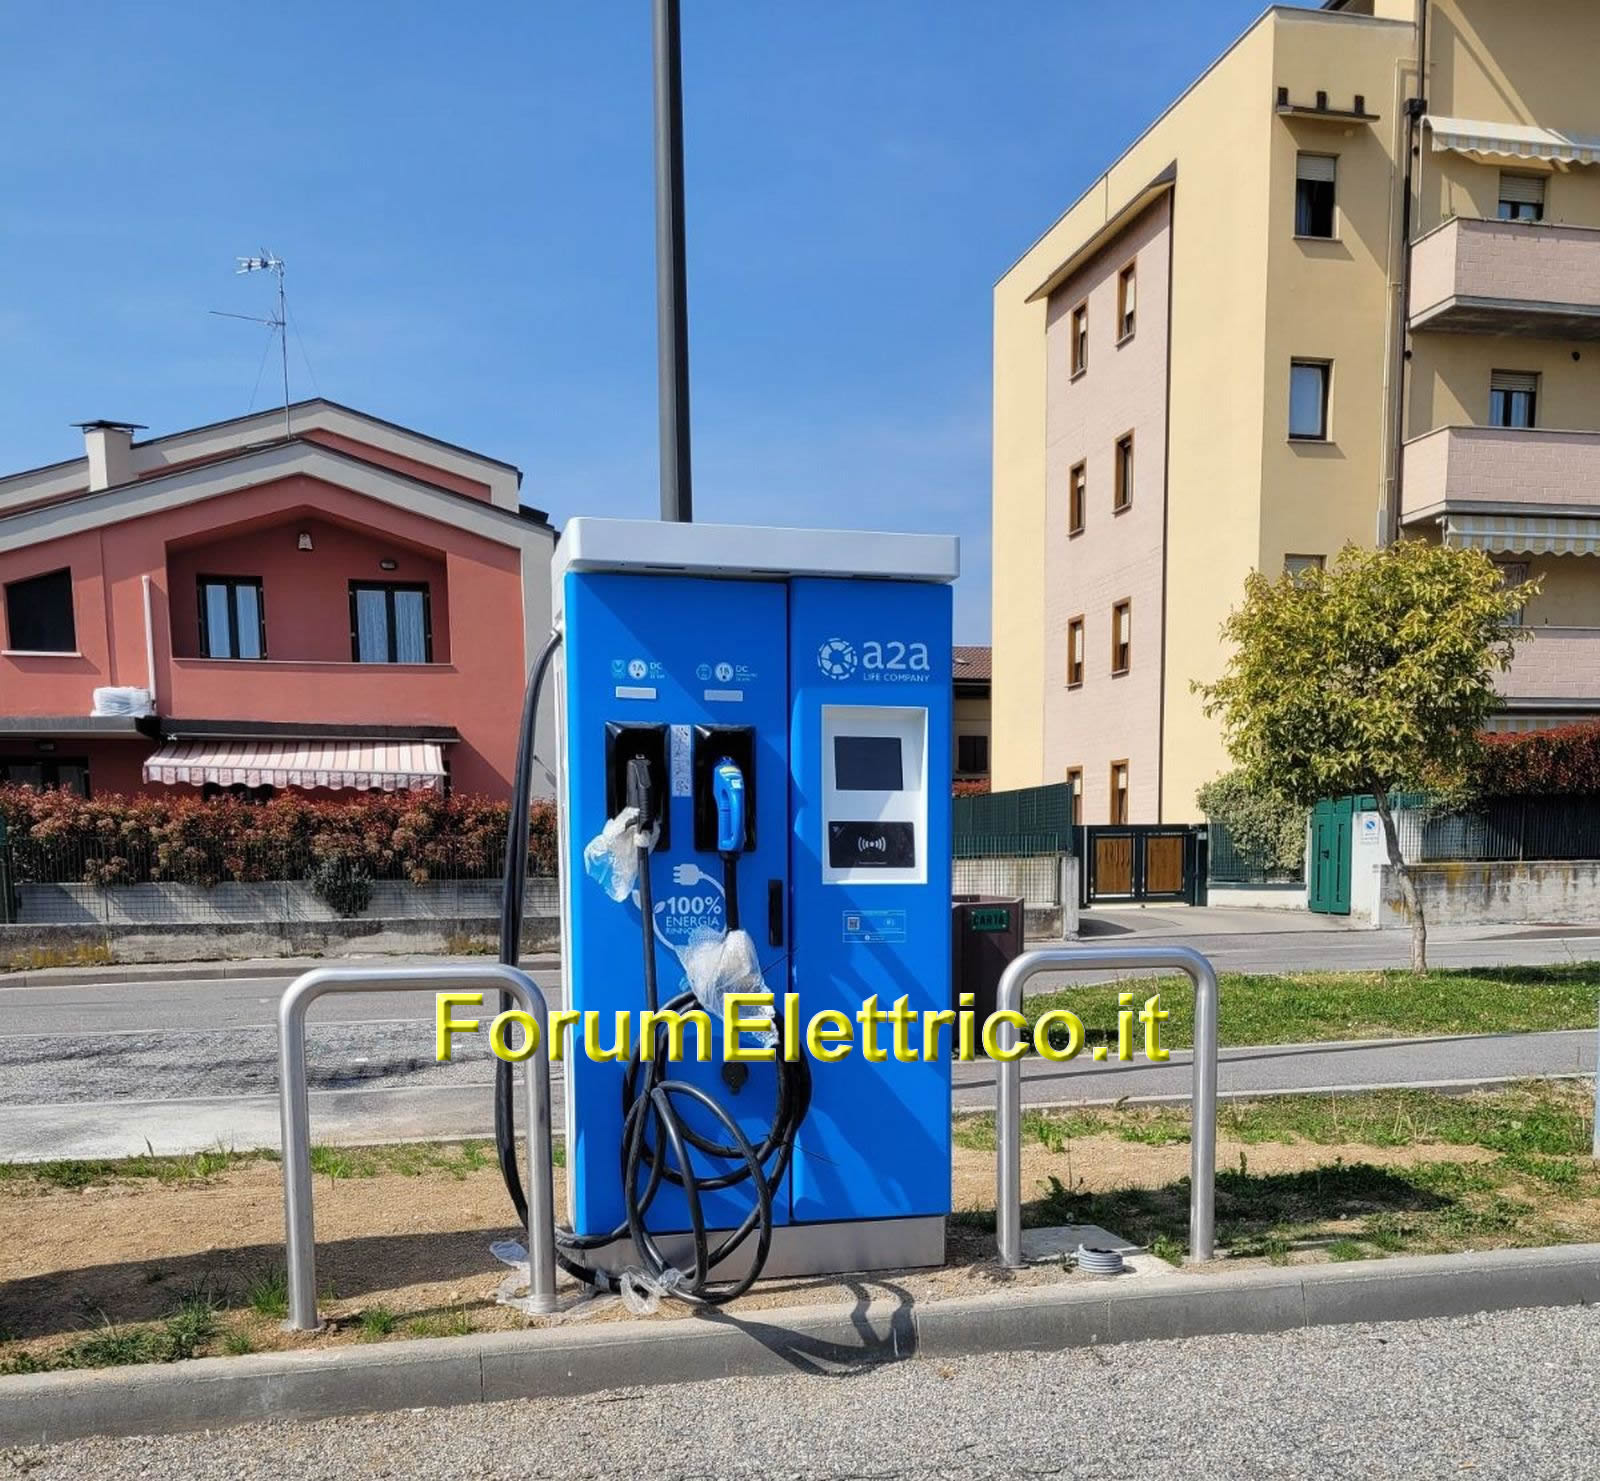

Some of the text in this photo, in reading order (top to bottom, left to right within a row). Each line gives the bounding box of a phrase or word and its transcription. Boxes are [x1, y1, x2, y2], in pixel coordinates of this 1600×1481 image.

[863, 641, 930, 671] a2a
[650, 662, 663, 670] DC
[863, 672, 930, 682] LIFE COMPANY
[667, 896, 722, 915] 100%
[666, 916, 720, 927] ENERGIA
